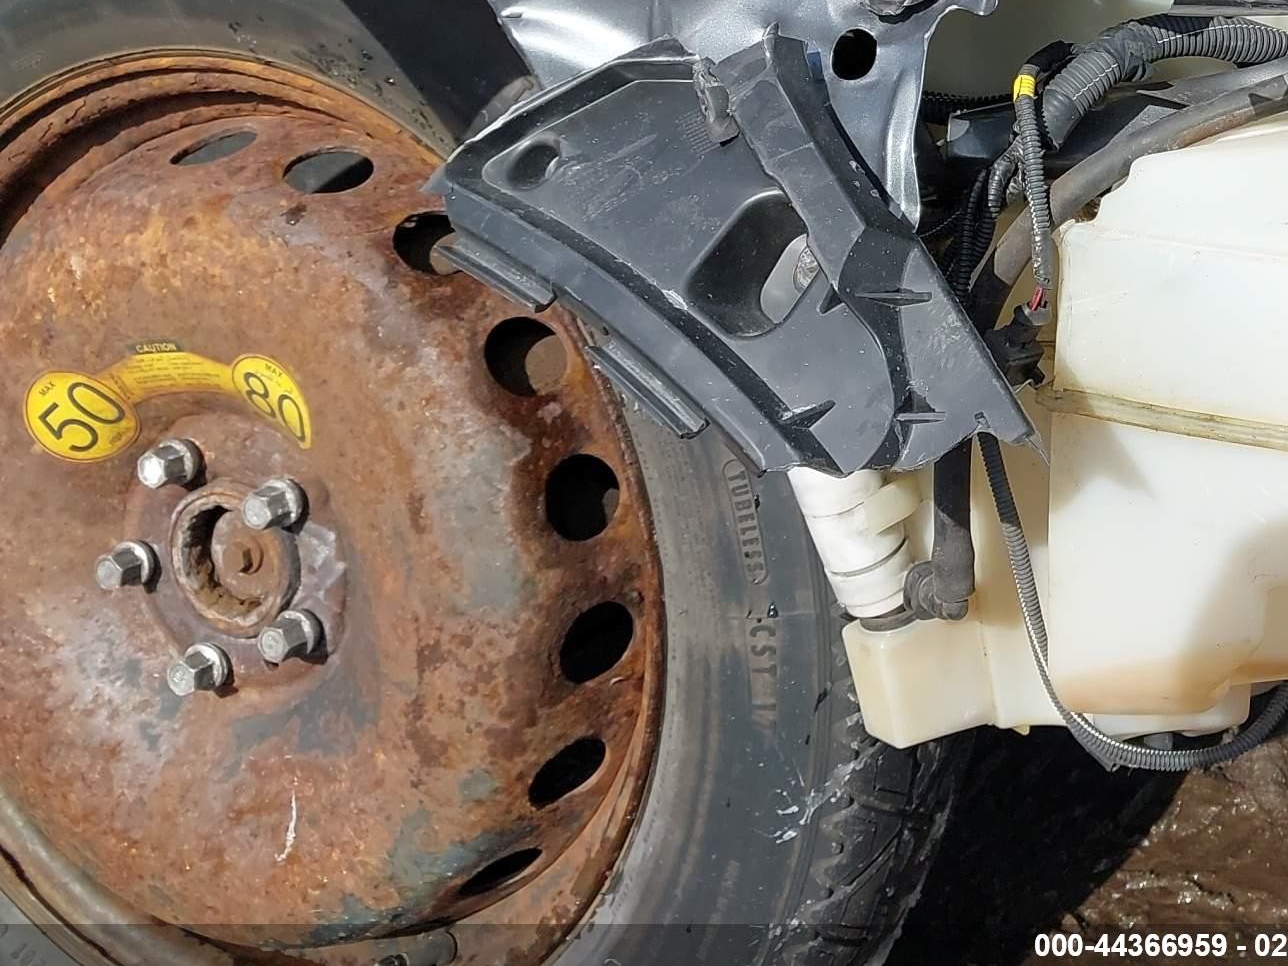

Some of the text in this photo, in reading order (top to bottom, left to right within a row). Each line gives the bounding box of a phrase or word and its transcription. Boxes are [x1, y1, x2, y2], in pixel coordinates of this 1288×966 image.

[135, 342, 177, 354] CAUTION
[38, 381, 56, 396] MAX
[38, 382, 125, 452] 50
[244, 372, 306, 442] 80
[727, 469, 765, 574] TUBELESS
[750, 624, 778, 677] CST
